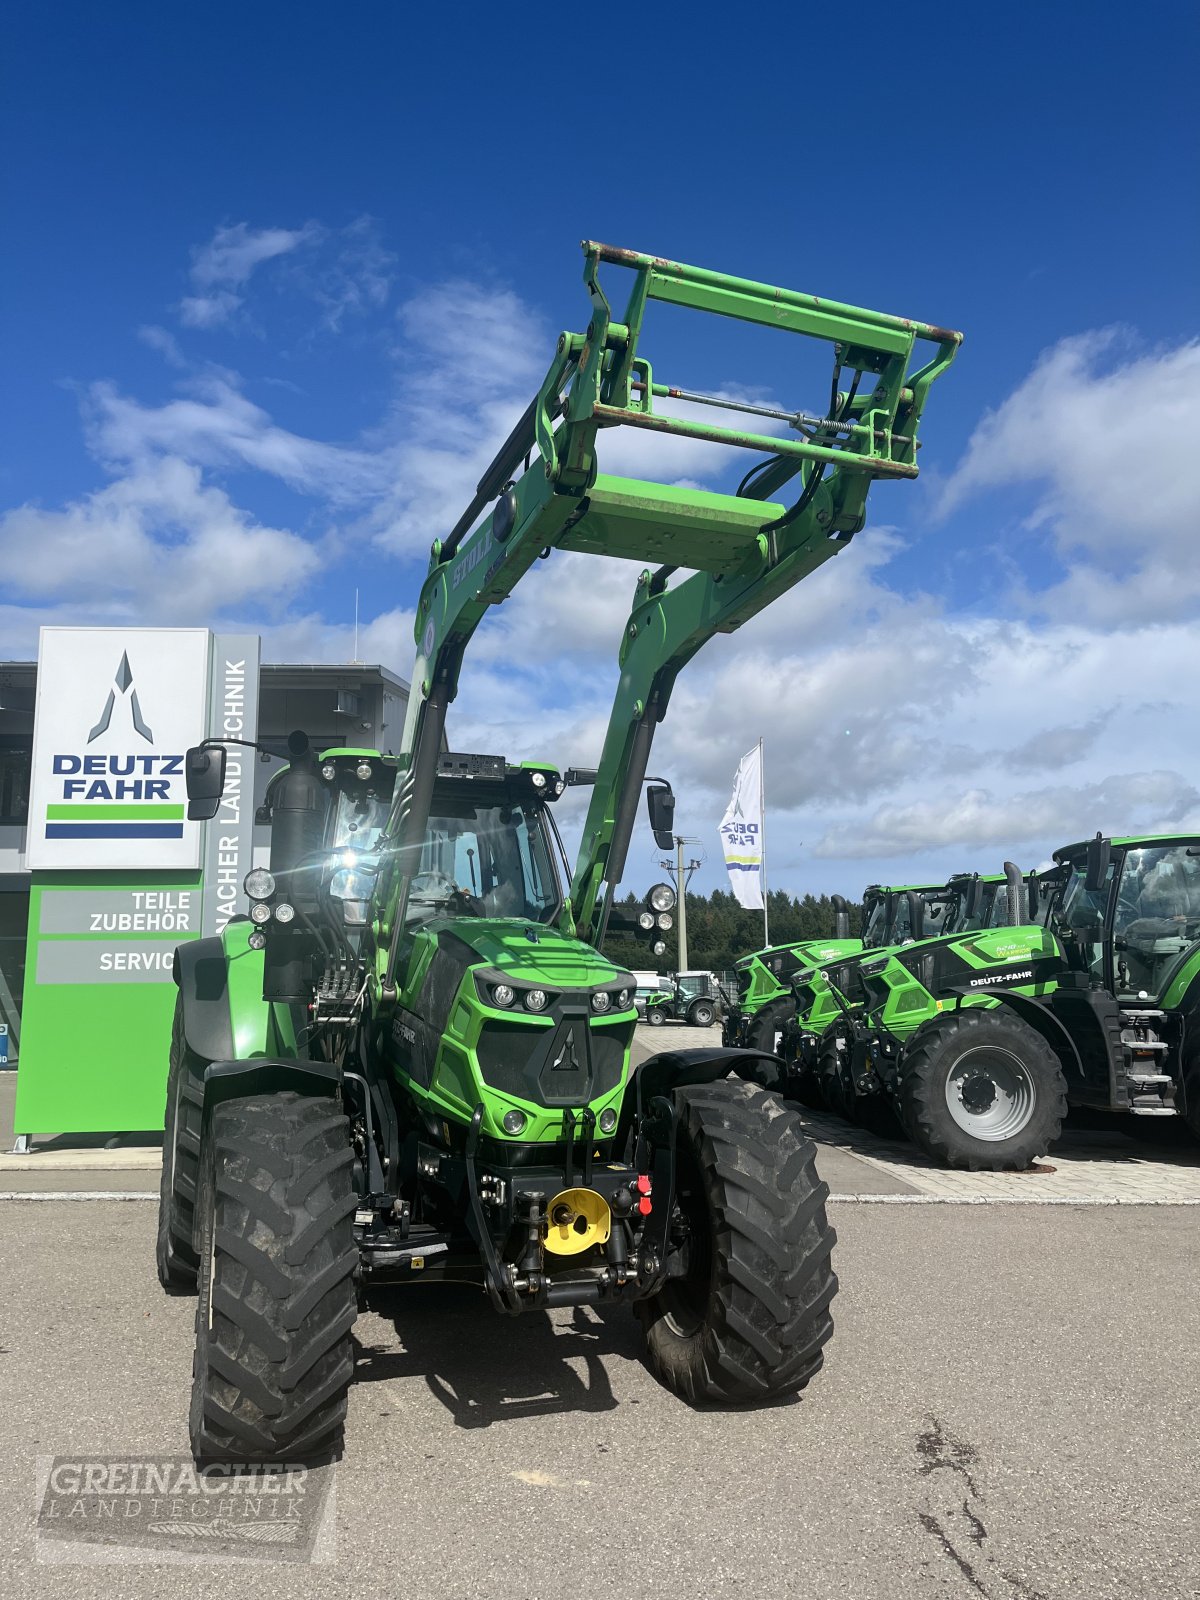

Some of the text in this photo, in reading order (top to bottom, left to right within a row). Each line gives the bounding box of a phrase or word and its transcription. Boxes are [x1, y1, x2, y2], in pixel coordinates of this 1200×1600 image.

[453, 529, 492, 590] STOLL
[220, 659, 246, 824] LANDTECHNIK
[52, 755, 184, 776] DEUTZ
[63, 779, 171, 800] FAHR
[131, 892, 191, 910] TEILE
[90, 909, 190, 931] ZUBEHÖR
[99, 952, 175, 971] SERVIC
[970, 971, 1032, 987] DEUTZ-FAHR
